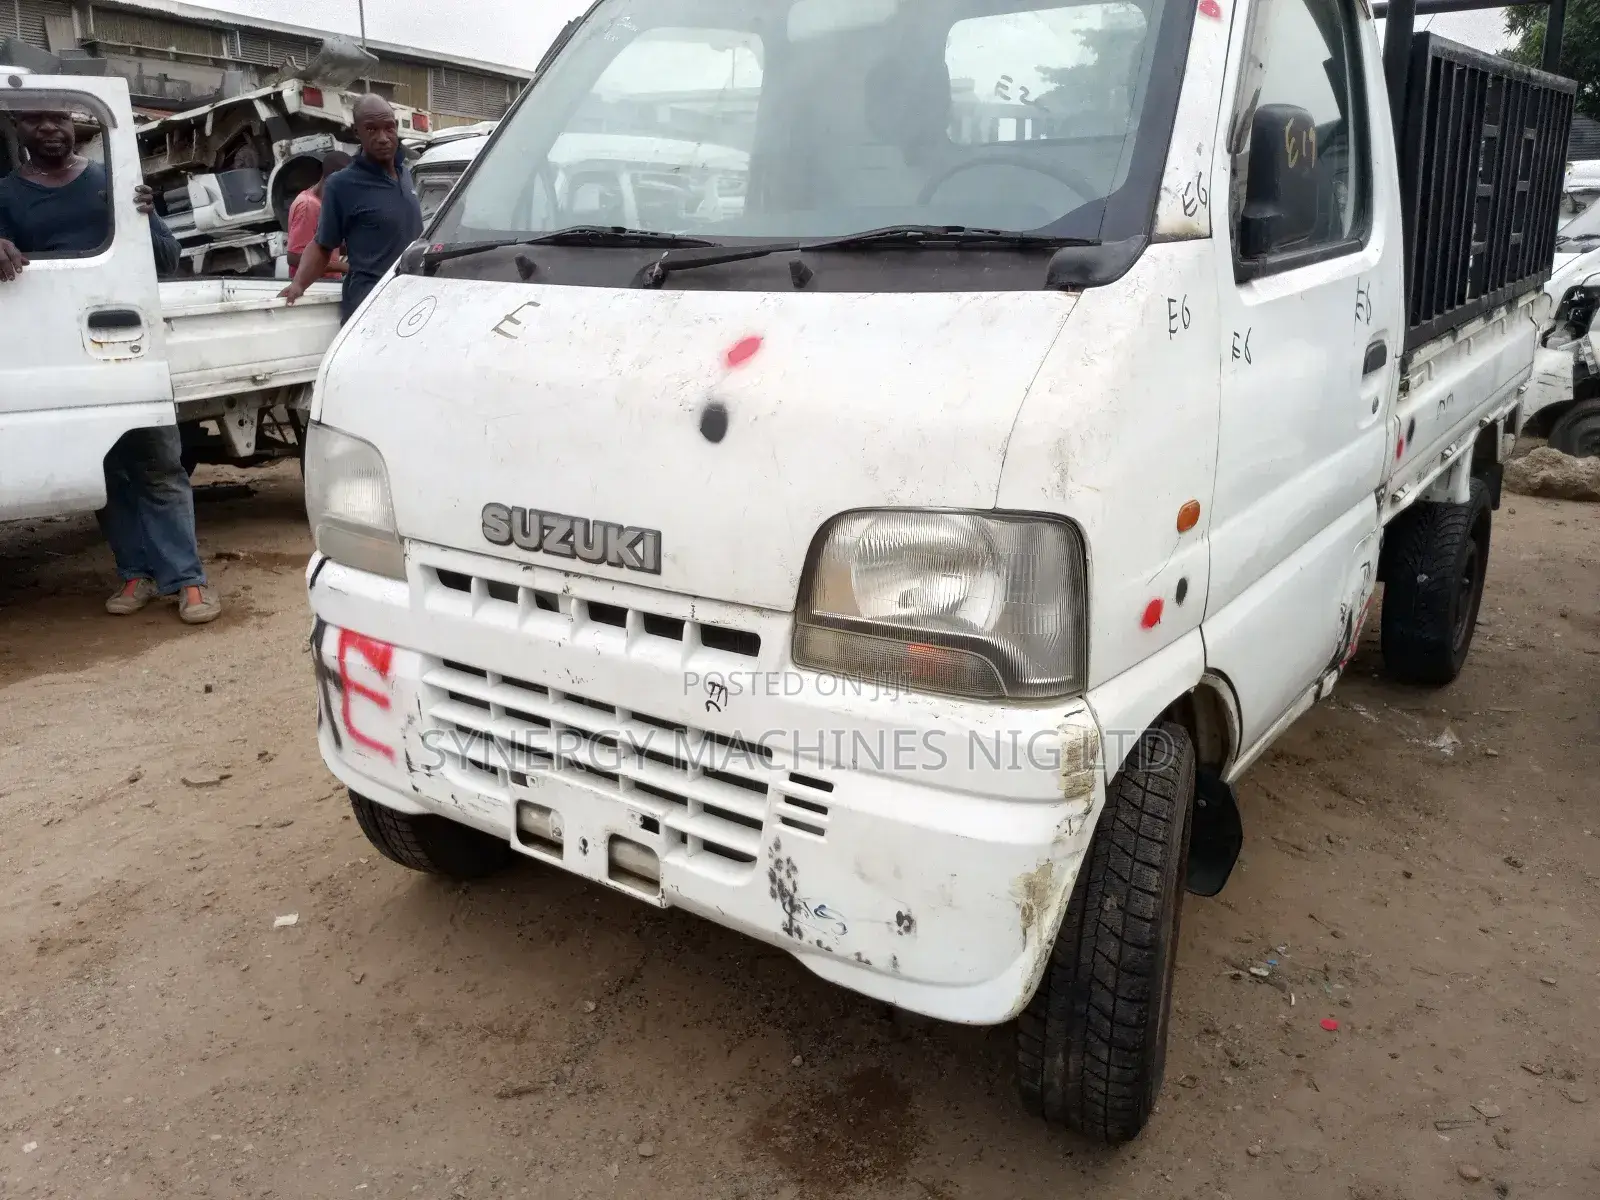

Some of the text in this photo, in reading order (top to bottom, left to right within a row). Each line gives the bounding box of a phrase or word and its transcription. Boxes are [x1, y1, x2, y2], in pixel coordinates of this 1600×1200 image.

[1181, 170, 1208, 218] E6
[491, 300, 541, 340] E
[1167, 293, 1191, 341] E6
[1231, 326, 1252, 365] E6
[481, 502, 662, 576] SUZUKI
[337, 627, 398, 766] E
